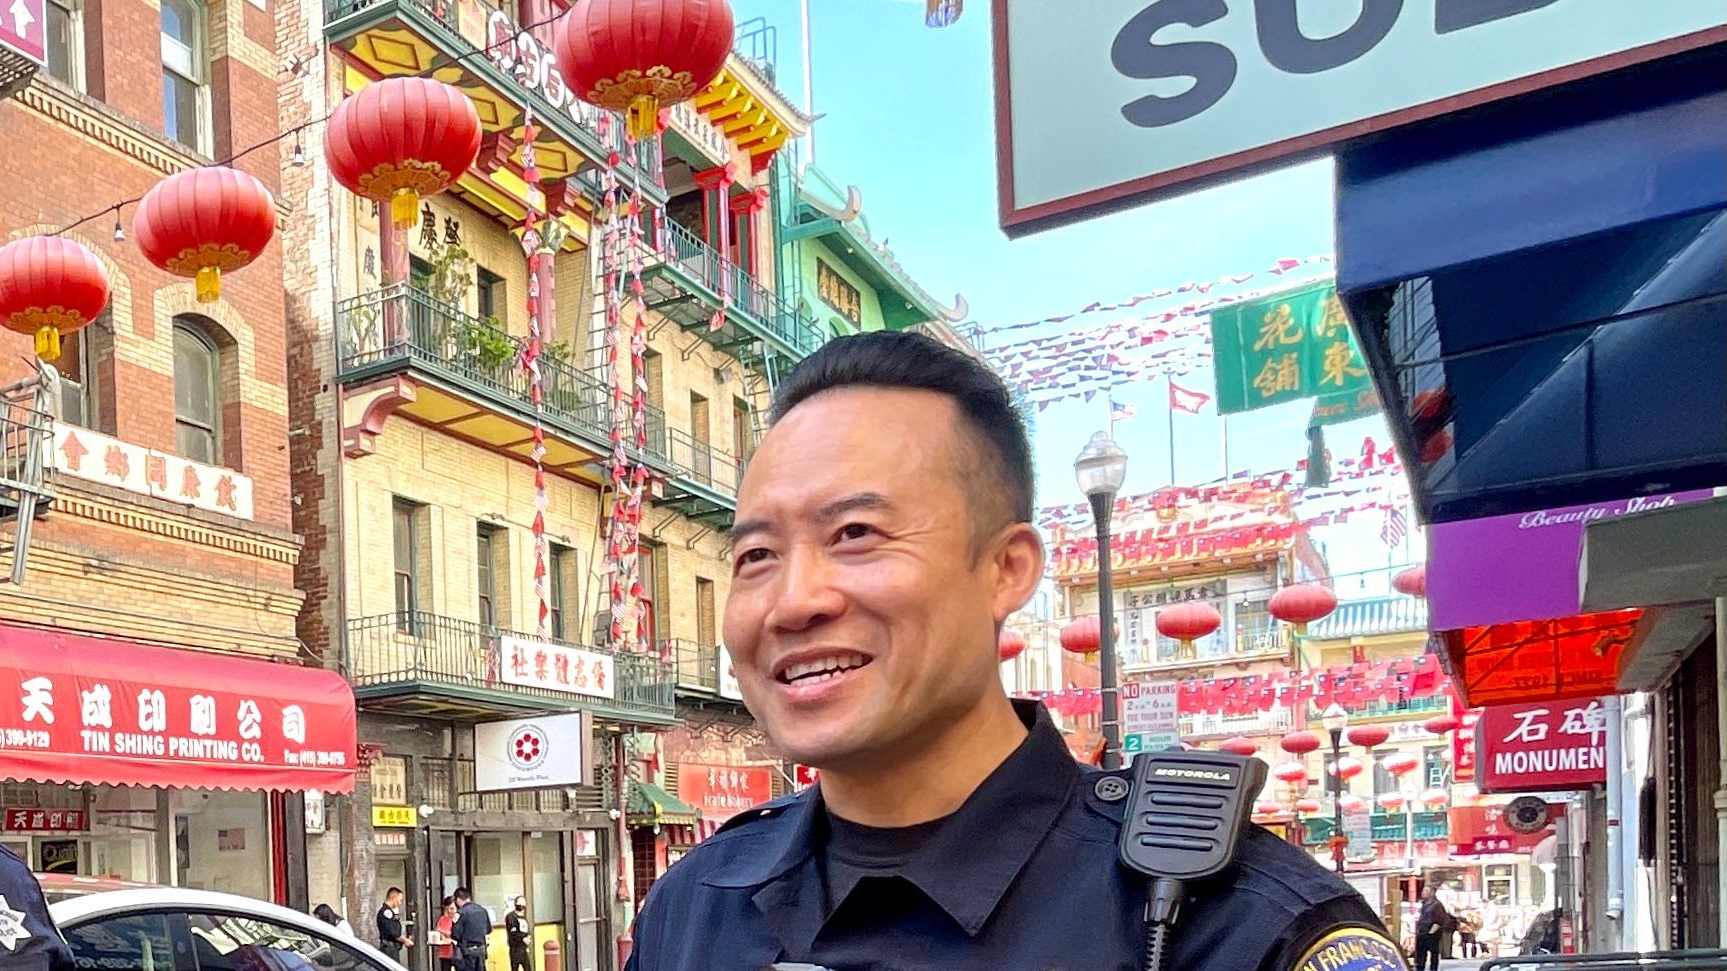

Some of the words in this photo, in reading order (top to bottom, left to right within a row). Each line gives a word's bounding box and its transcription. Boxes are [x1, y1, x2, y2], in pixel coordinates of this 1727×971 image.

[1518, 508, 1606, 529] Beauty
[1123, 684, 1139, 698] NO
[1141, 684, 1176, 696] PARKING
[20, 676, 308, 744] 天成印刷公司
[1503, 701, 1607, 746] 石碑
[80, 730, 110, 752] TIN
[114, 733, 165, 757] SHING
[169, 735, 239, 762] PRINTING
[241, 742, 266, 763] CO.
[1128, 737, 1139, 751] 2
[1154, 768, 1231, 781] MOTOROLA
